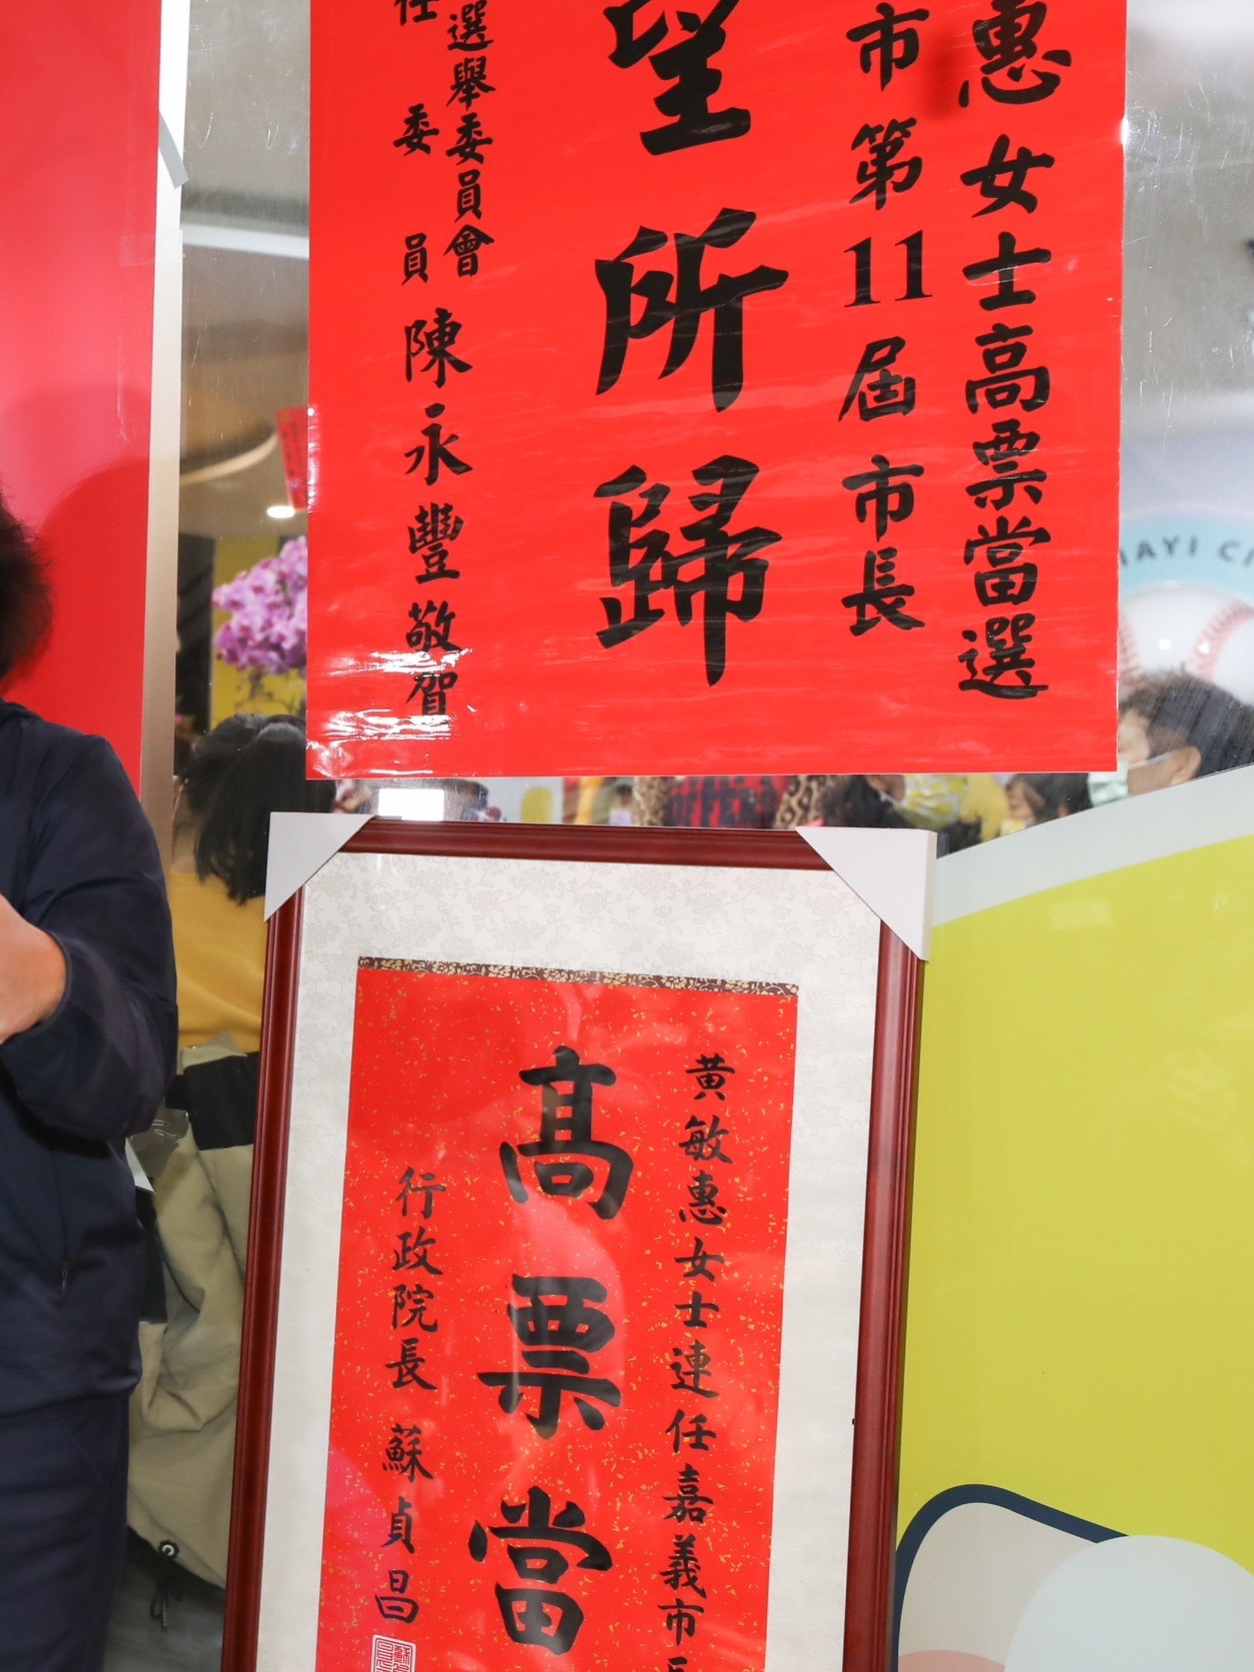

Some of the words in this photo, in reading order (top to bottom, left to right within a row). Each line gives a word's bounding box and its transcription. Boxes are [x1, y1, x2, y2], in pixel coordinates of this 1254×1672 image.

[443, 0, 496, 277] 選舉委員會
